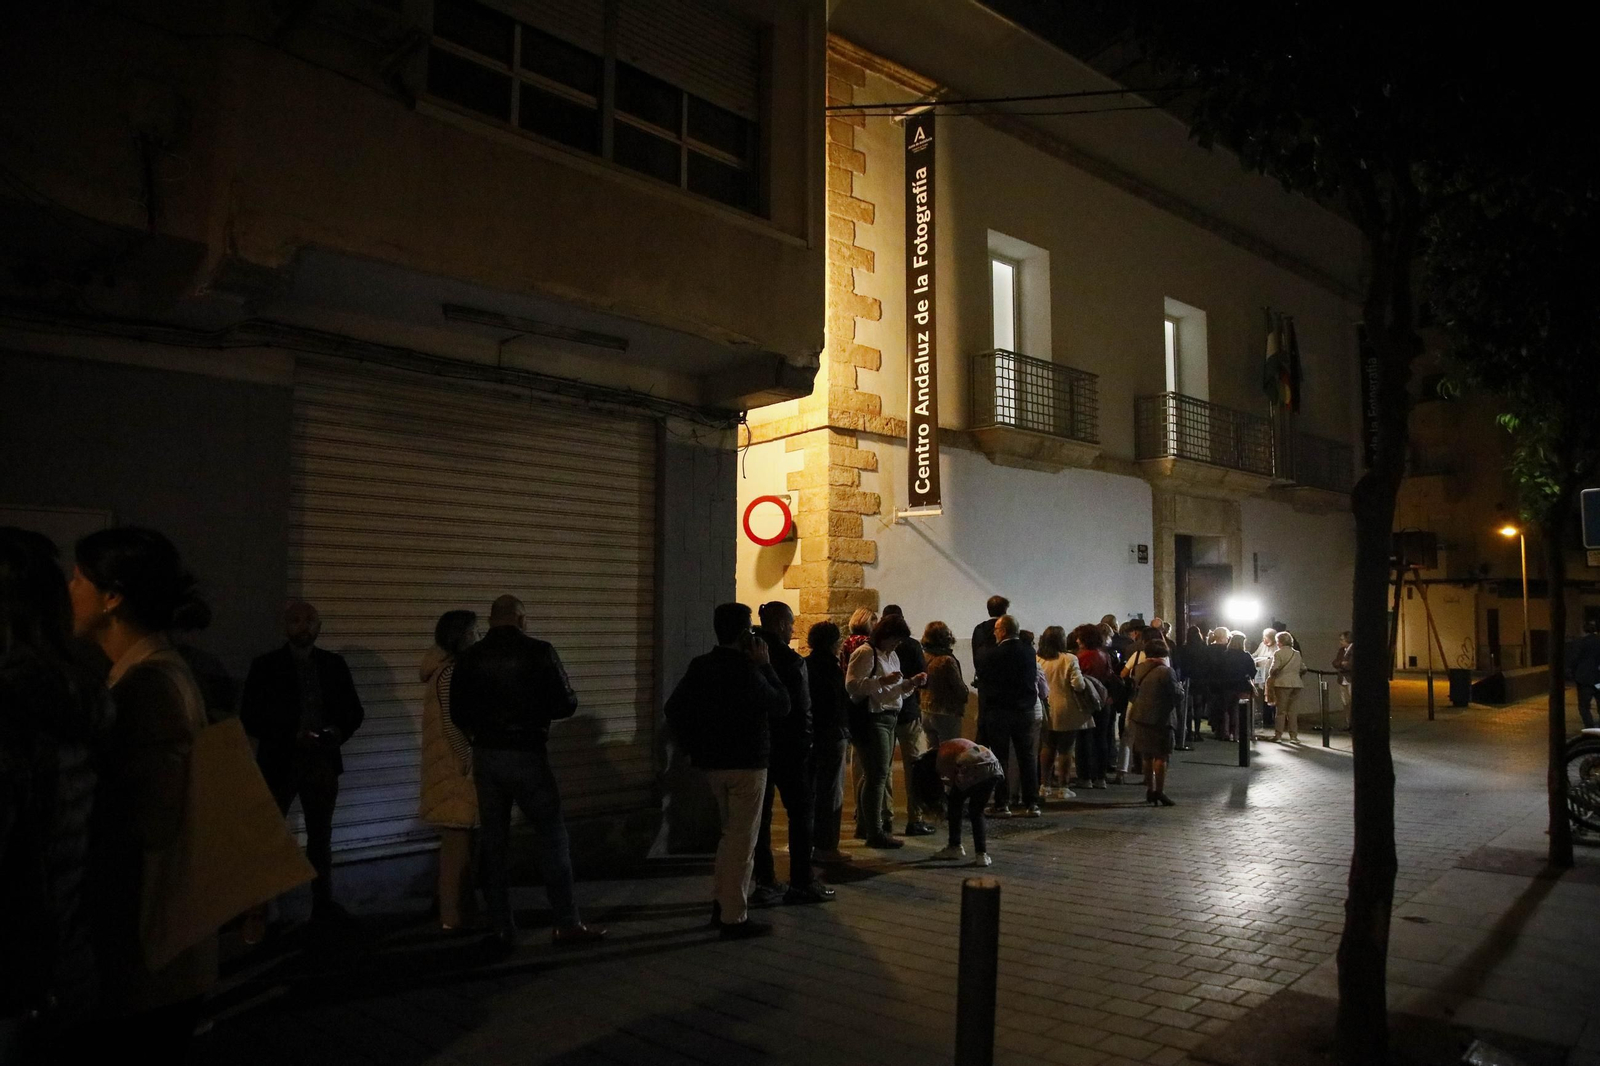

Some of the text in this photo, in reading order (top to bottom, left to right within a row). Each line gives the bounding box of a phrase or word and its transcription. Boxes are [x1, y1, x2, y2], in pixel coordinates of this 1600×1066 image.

[912, 166, 931, 269] Fotografía
[913, 274, 929, 295] la
[913, 299, 930, 326] de
[914, 331, 930, 416] Andaluz
[914, 423, 931, 494] Centro
